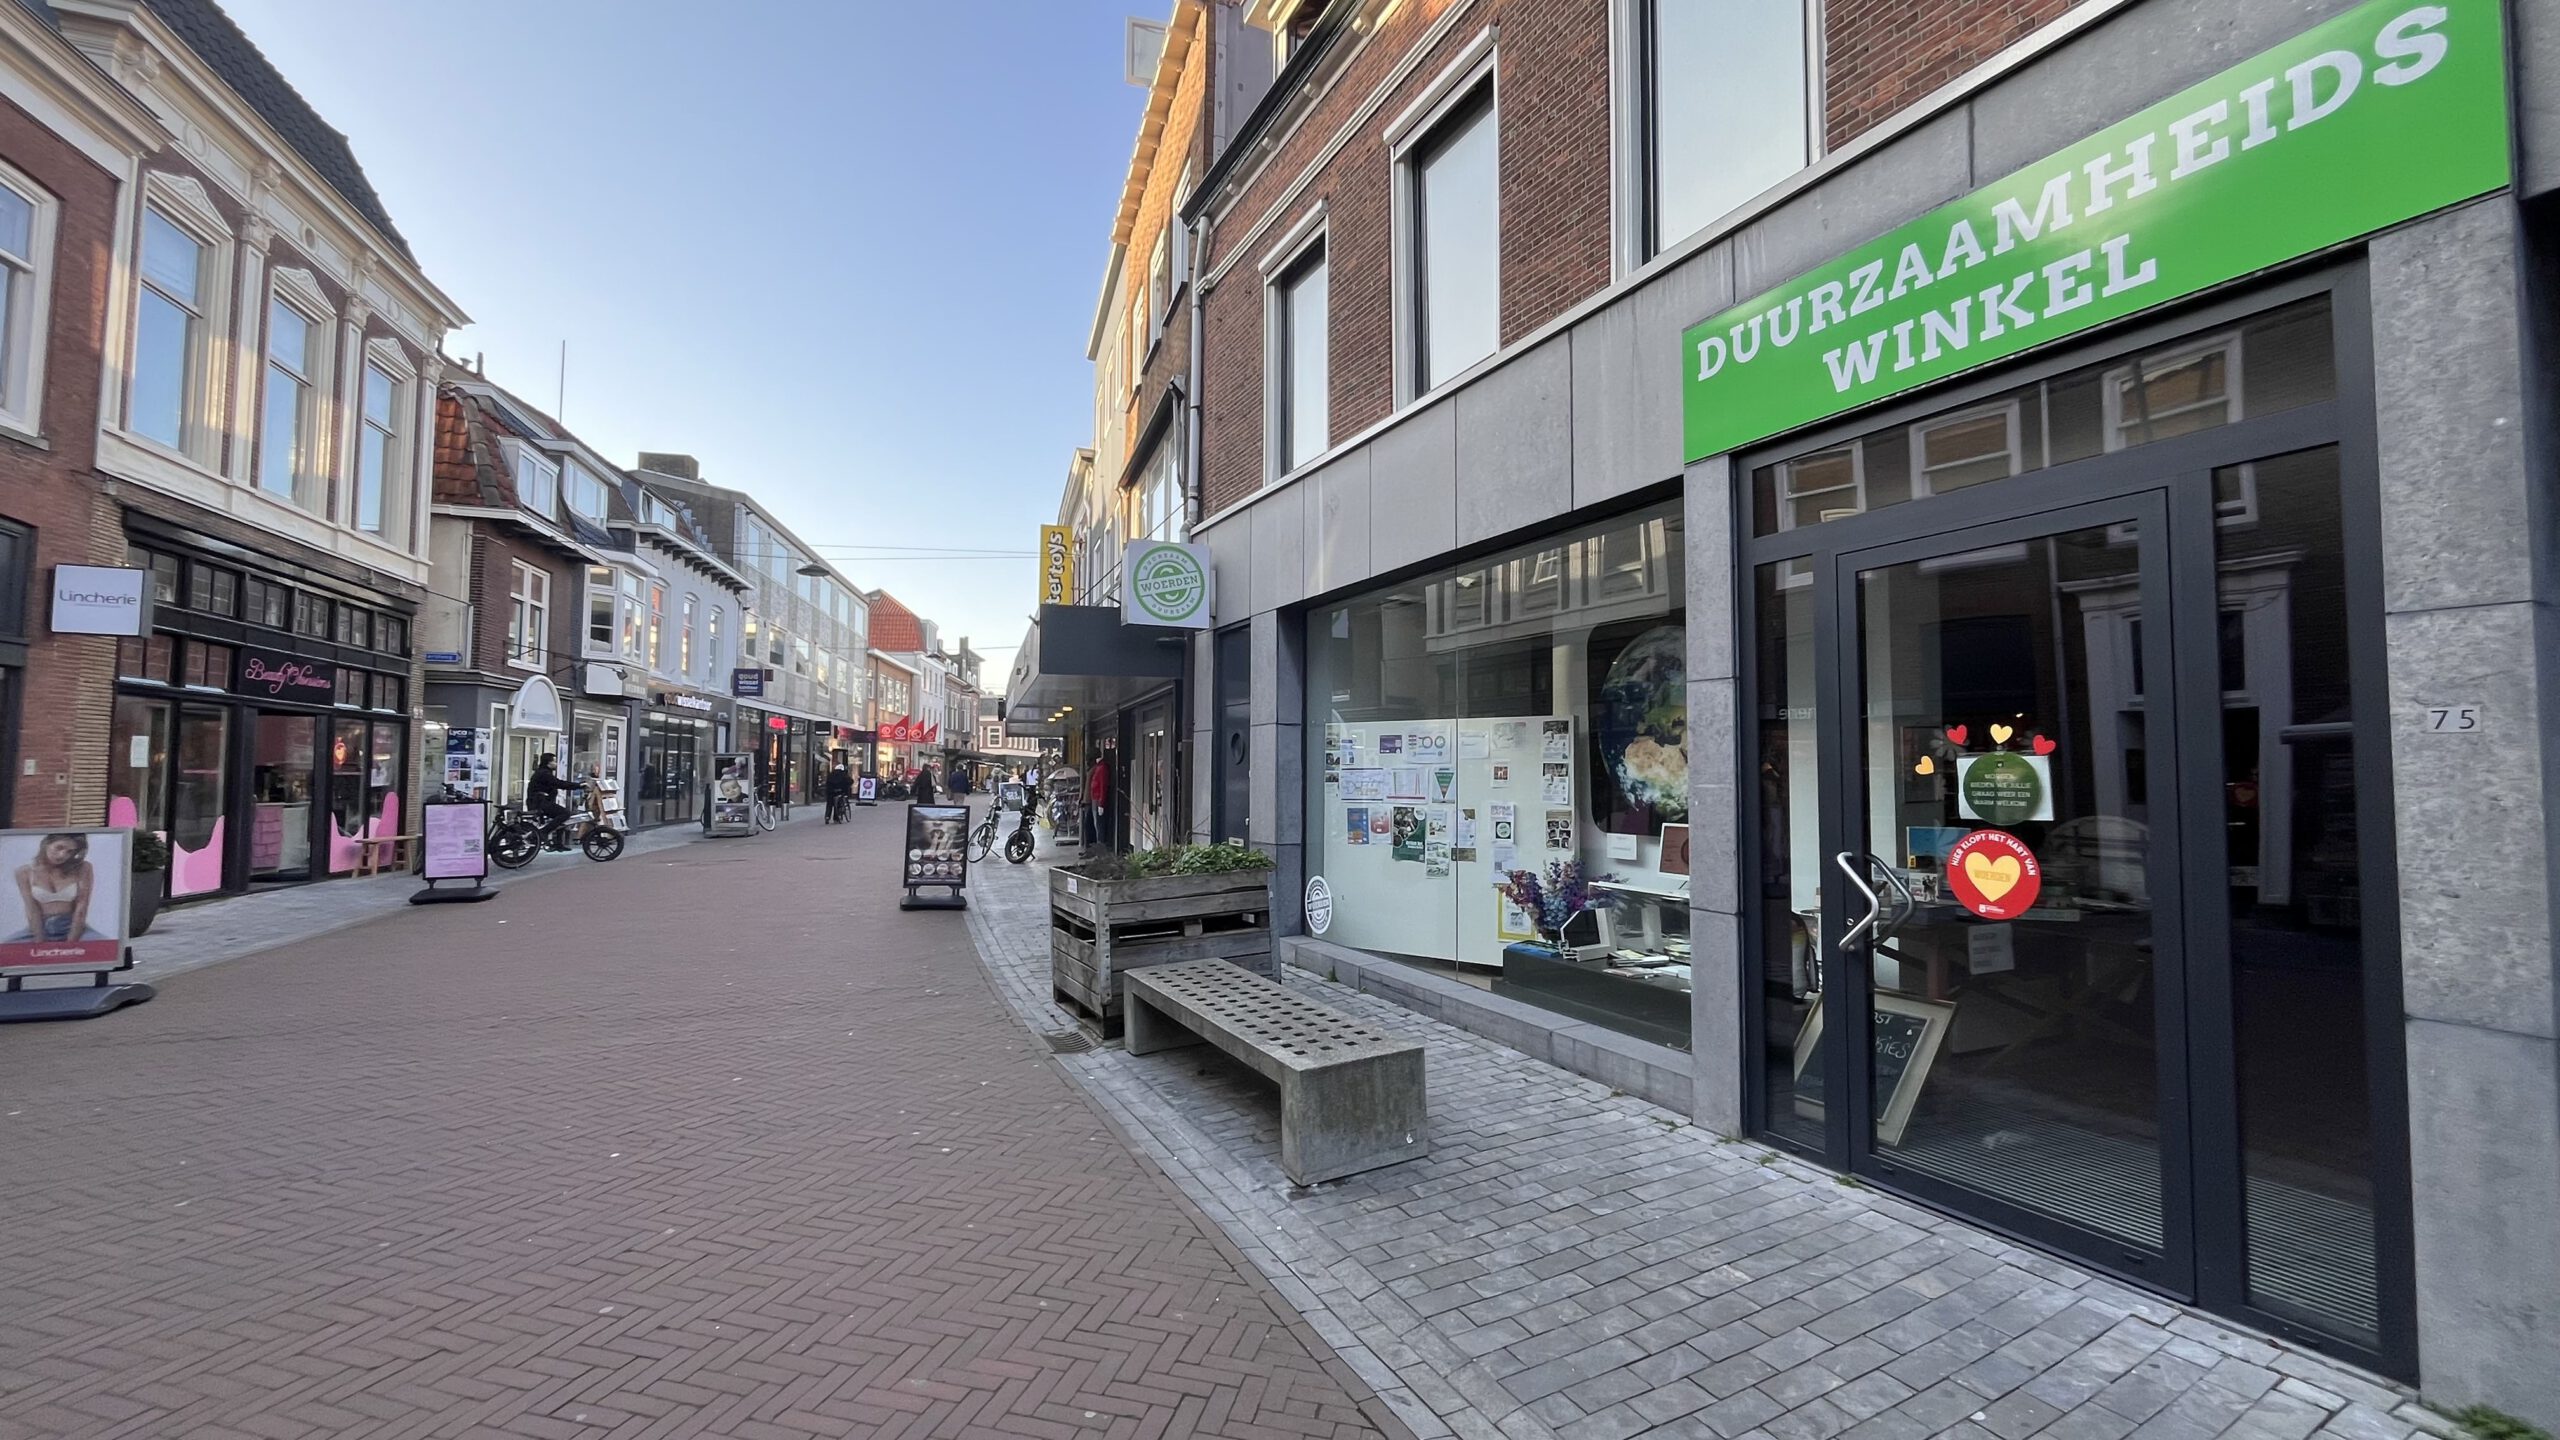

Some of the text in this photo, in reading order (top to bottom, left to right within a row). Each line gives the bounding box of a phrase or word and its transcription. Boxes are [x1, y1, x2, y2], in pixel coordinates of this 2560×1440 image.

[1697, 5, 2449, 382] DUURZAAMHEIDS
[1822, 232, 2158, 394] WINKEL
[59, 589, 137, 605] Lincherie
[1140, 575, 1199, 593] WOERDEN
[2429, 708, 2476, 730] 75
[1951, 833, 2036, 876] HIER KLOPT HET HART VAN
